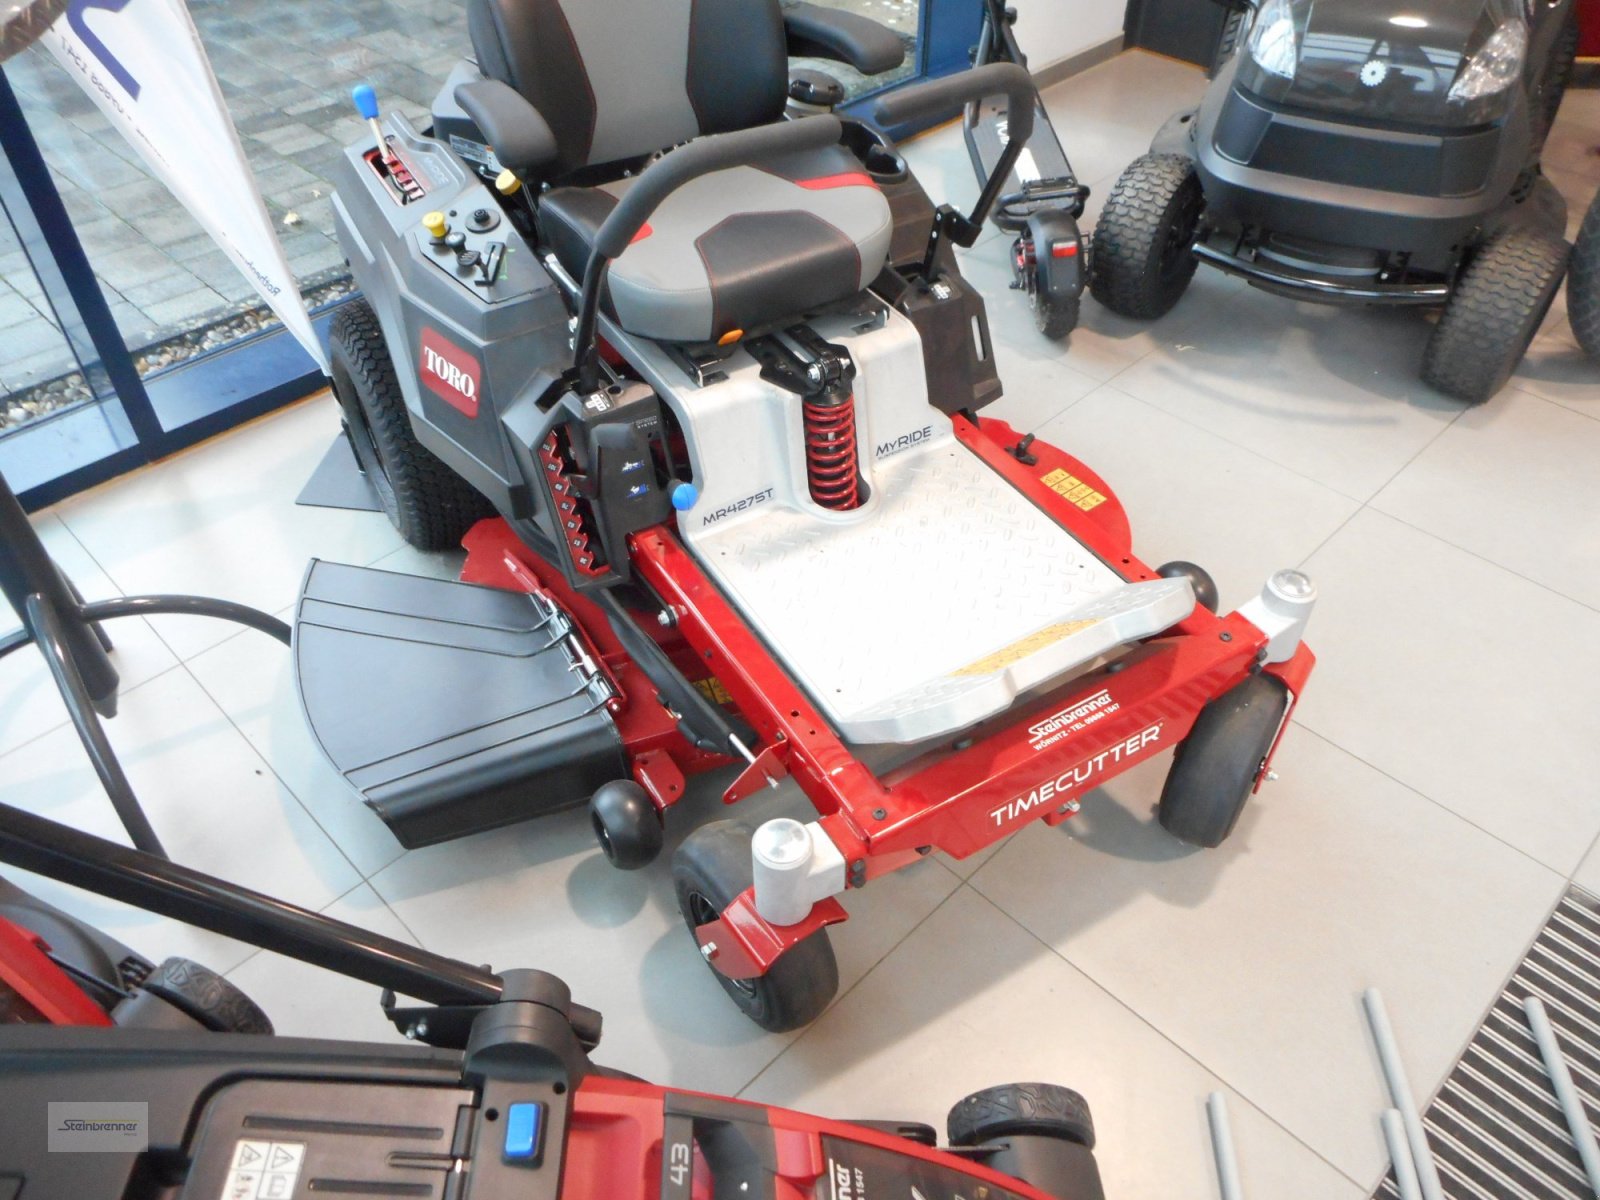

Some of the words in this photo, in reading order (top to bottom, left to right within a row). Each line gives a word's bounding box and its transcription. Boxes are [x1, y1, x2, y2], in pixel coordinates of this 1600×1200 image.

[424, 346, 476, 400] TORO
[703, 488, 774, 526] MR4275T
[1028, 689, 1113, 744] Steinbrenner
[1103, 703, 1120, 714] 1547
[990, 726, 1161, 827] TIMECUTTER
[670, 1143, 689, 1186] 43
